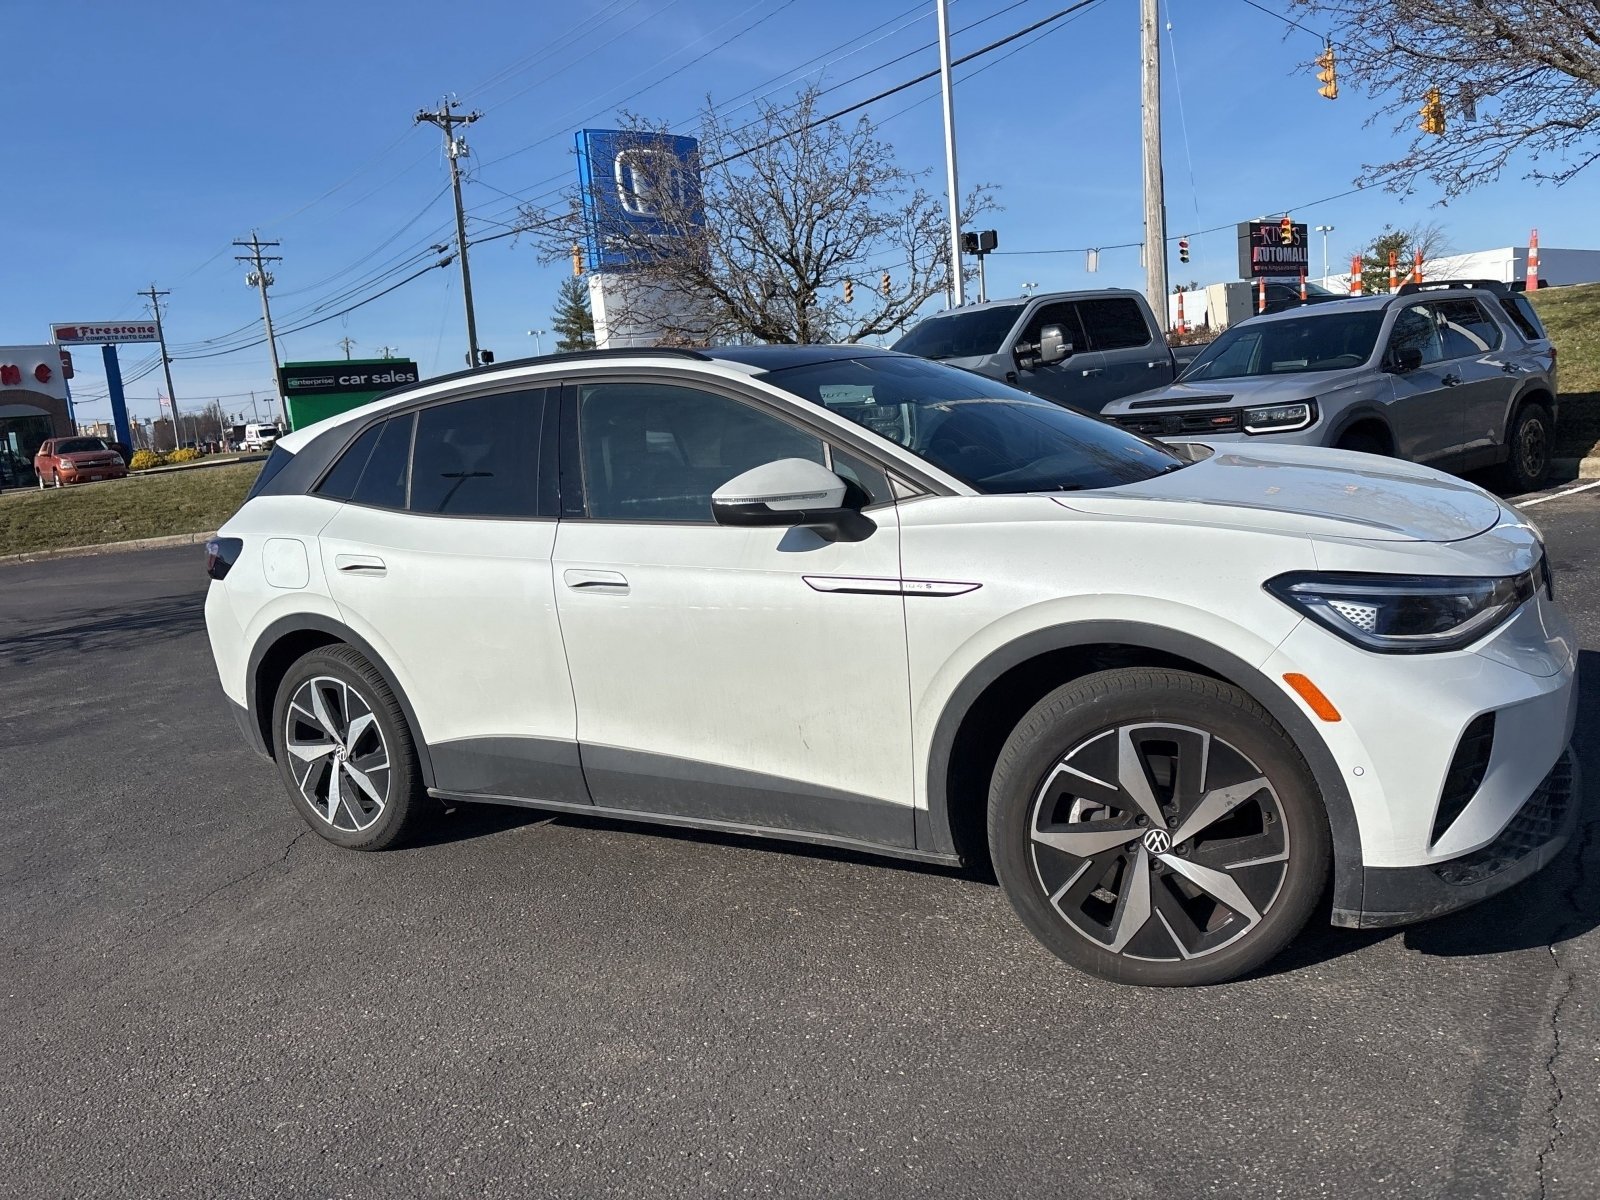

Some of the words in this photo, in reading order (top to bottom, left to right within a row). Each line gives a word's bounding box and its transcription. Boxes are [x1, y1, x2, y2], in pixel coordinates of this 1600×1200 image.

[1260, 226, 1301, 245] KINS
[1253, 246, 1308, 262] AUTOMALL
[79, 326, 155, 336] Firestone
[289, 378, 334, 387] enterprise
[339, 375, 368, 385] car
[372, 370, 415, 384] sales
